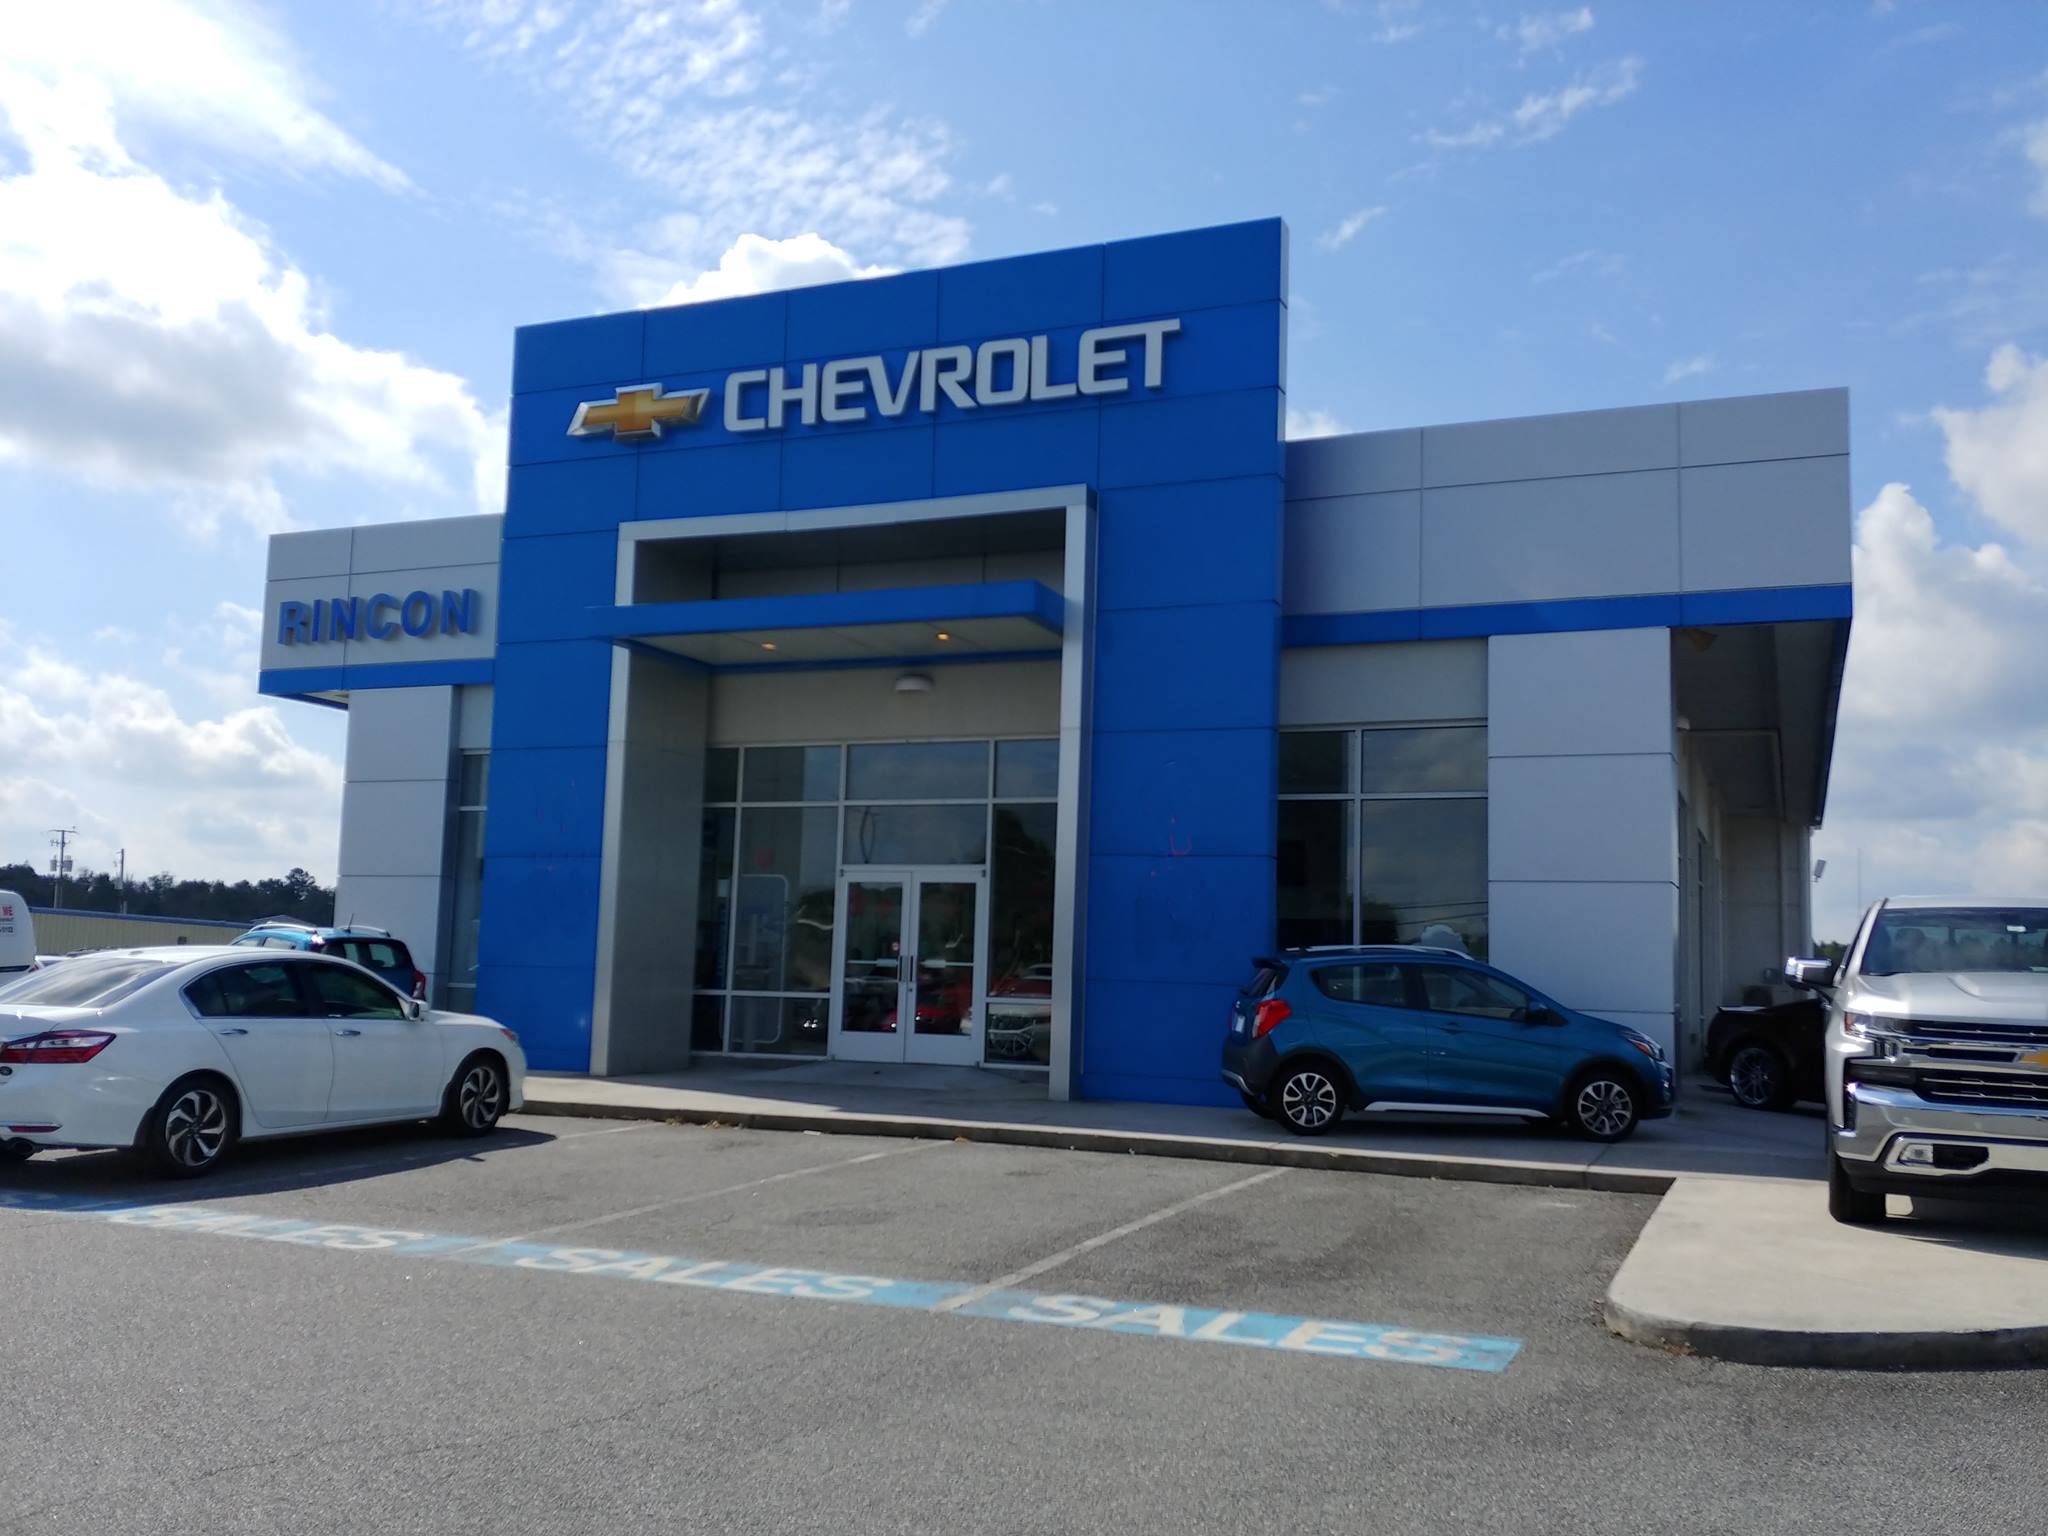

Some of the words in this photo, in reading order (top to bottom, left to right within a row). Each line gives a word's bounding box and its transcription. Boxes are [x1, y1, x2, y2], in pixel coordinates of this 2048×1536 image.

[723, 318, 1181, 433] CHEVROLET
[277, 588, 477, 644] RINCON
[514, 1247, 894, 1299] SALES
[1008, 1295, 1472, 1362] SALES
